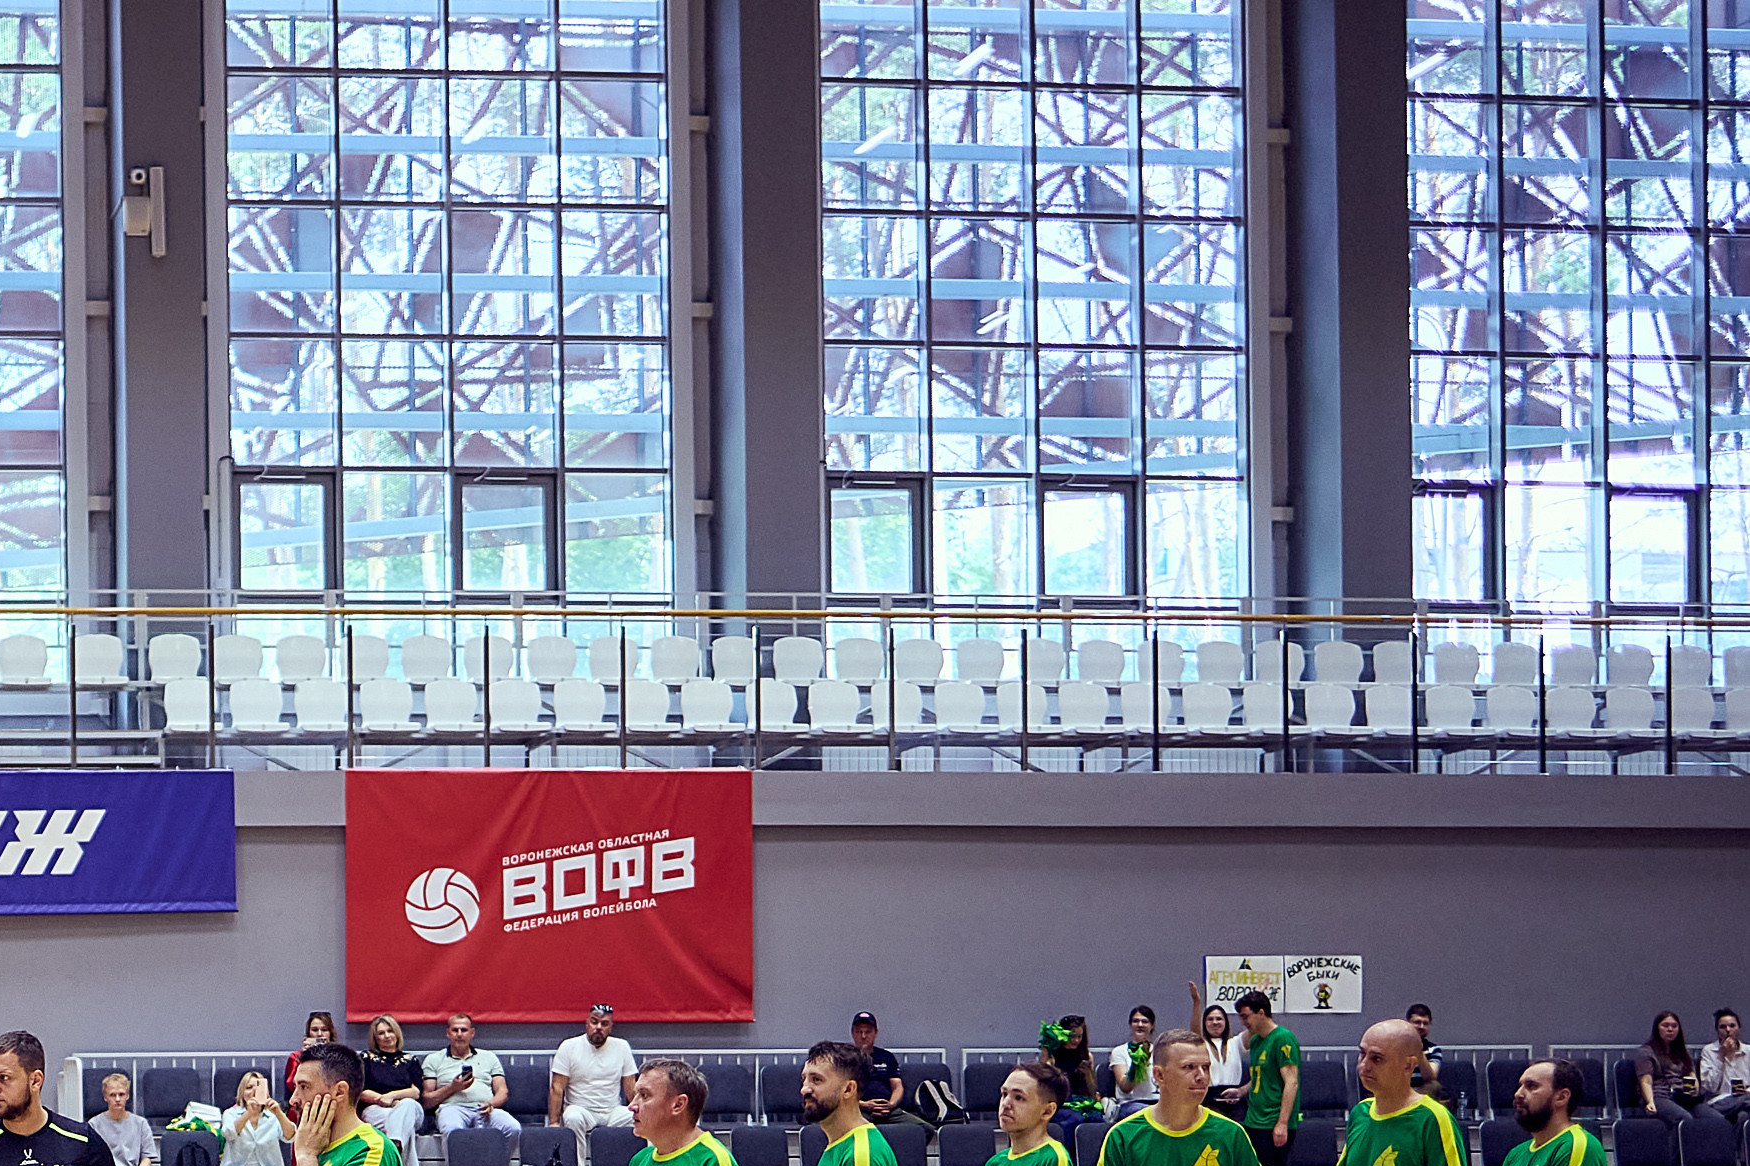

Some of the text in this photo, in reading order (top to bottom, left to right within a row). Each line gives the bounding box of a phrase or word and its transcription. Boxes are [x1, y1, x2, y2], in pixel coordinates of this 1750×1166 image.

[502, 829, 670, 866] ВОРОНЕЖСКАЯ ОБЛАСТНАЯ
[503, 836, 695, 920] ВОФВ
[503, 897, 657, 933] ФЕДЕРАЦИЯ ВОЛЕЙБОЛА
[1286, 957, 1361, 979] ВОРОНЕЖСКИЕ
[1306, 969, 1340, 983] БЫКИ
[1215, 985, 1282, 1002] ВОРОЖ
